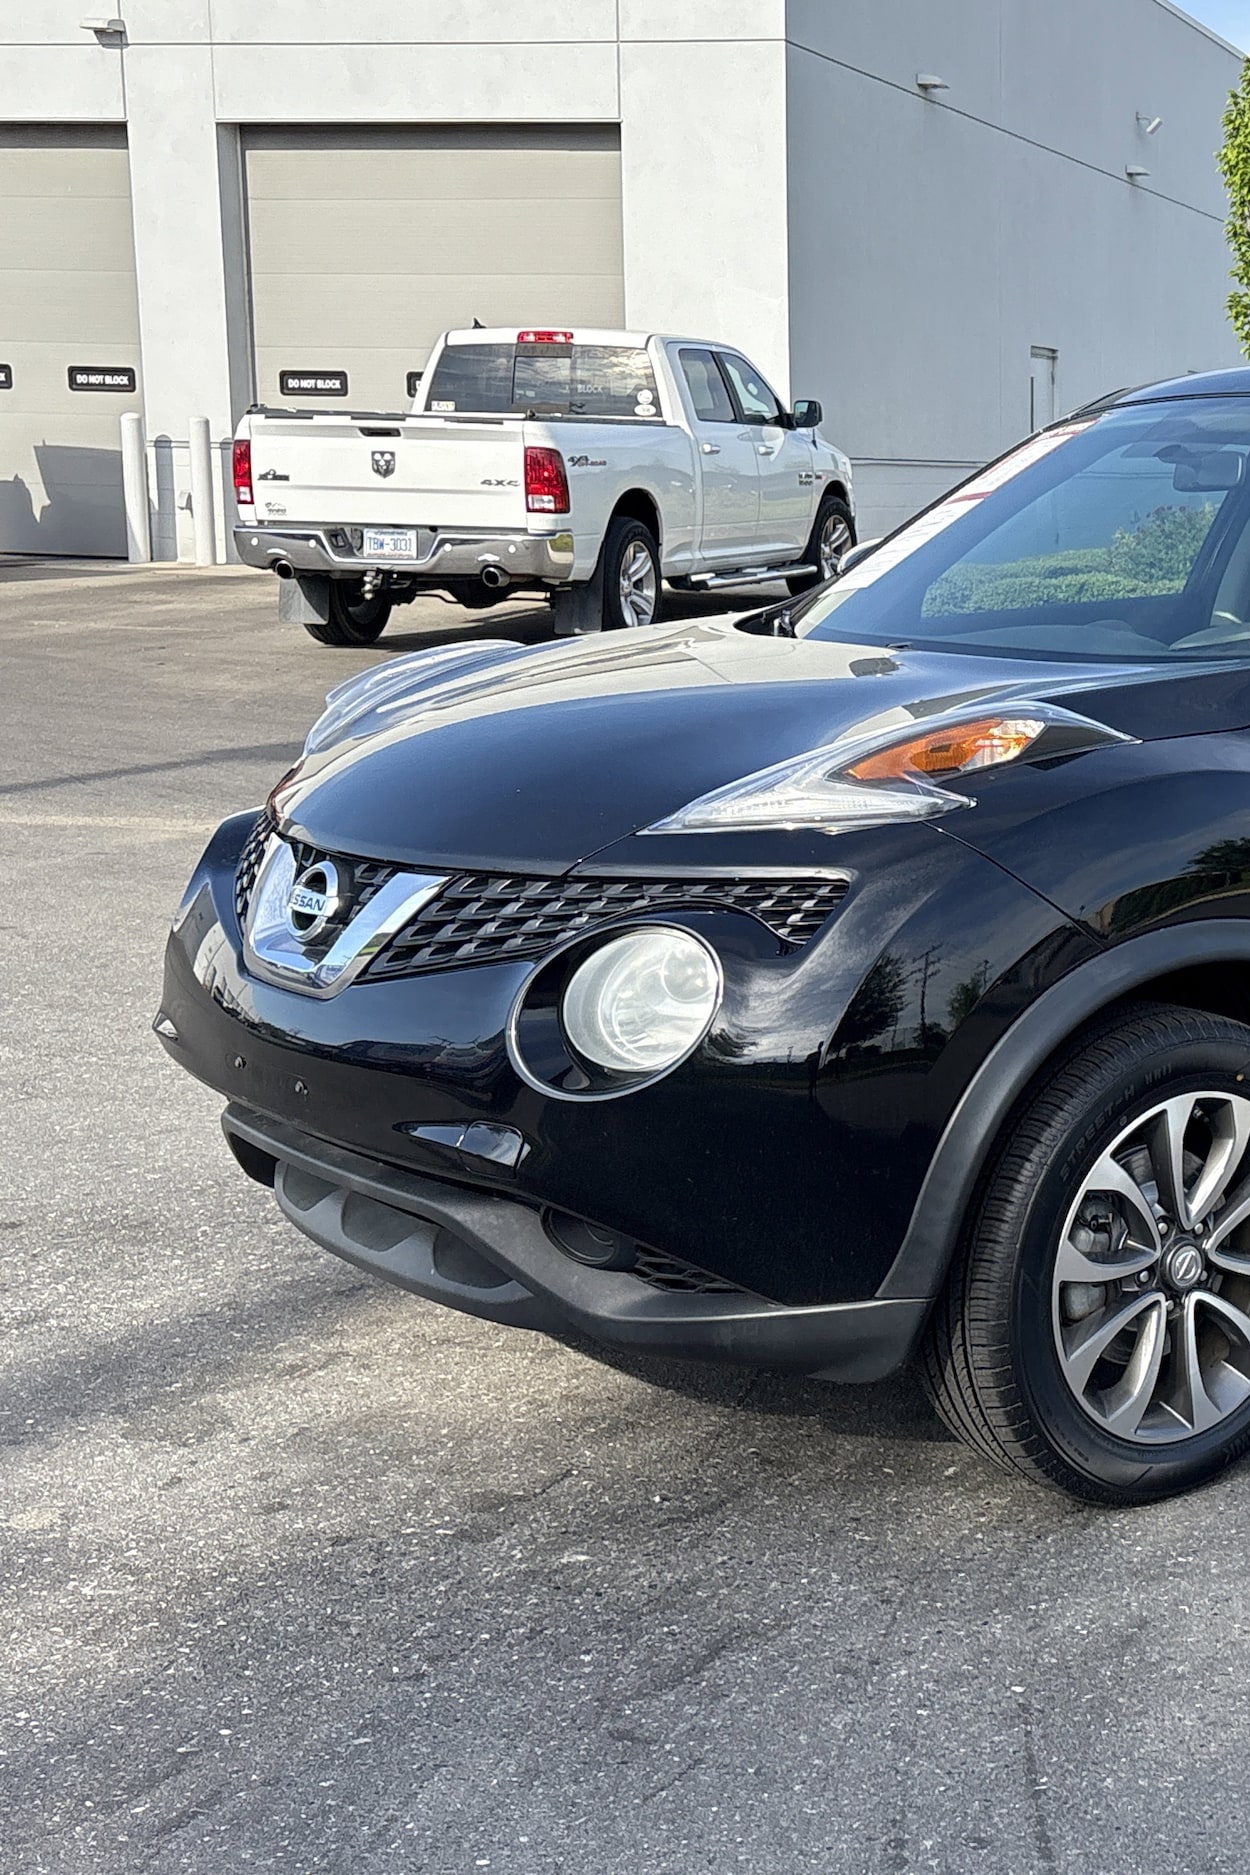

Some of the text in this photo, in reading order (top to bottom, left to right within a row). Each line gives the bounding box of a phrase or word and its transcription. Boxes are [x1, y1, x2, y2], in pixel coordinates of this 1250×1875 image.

[76, 374, 129, 385] DO NOT BLOCK
[287, 379, 341, 389] DO NOT BLOCK
[577, 384, 604, 393] BLOCK
[367, 537, 412, 551] TBW-3031
[292, 894, 326, 911] SSAN
